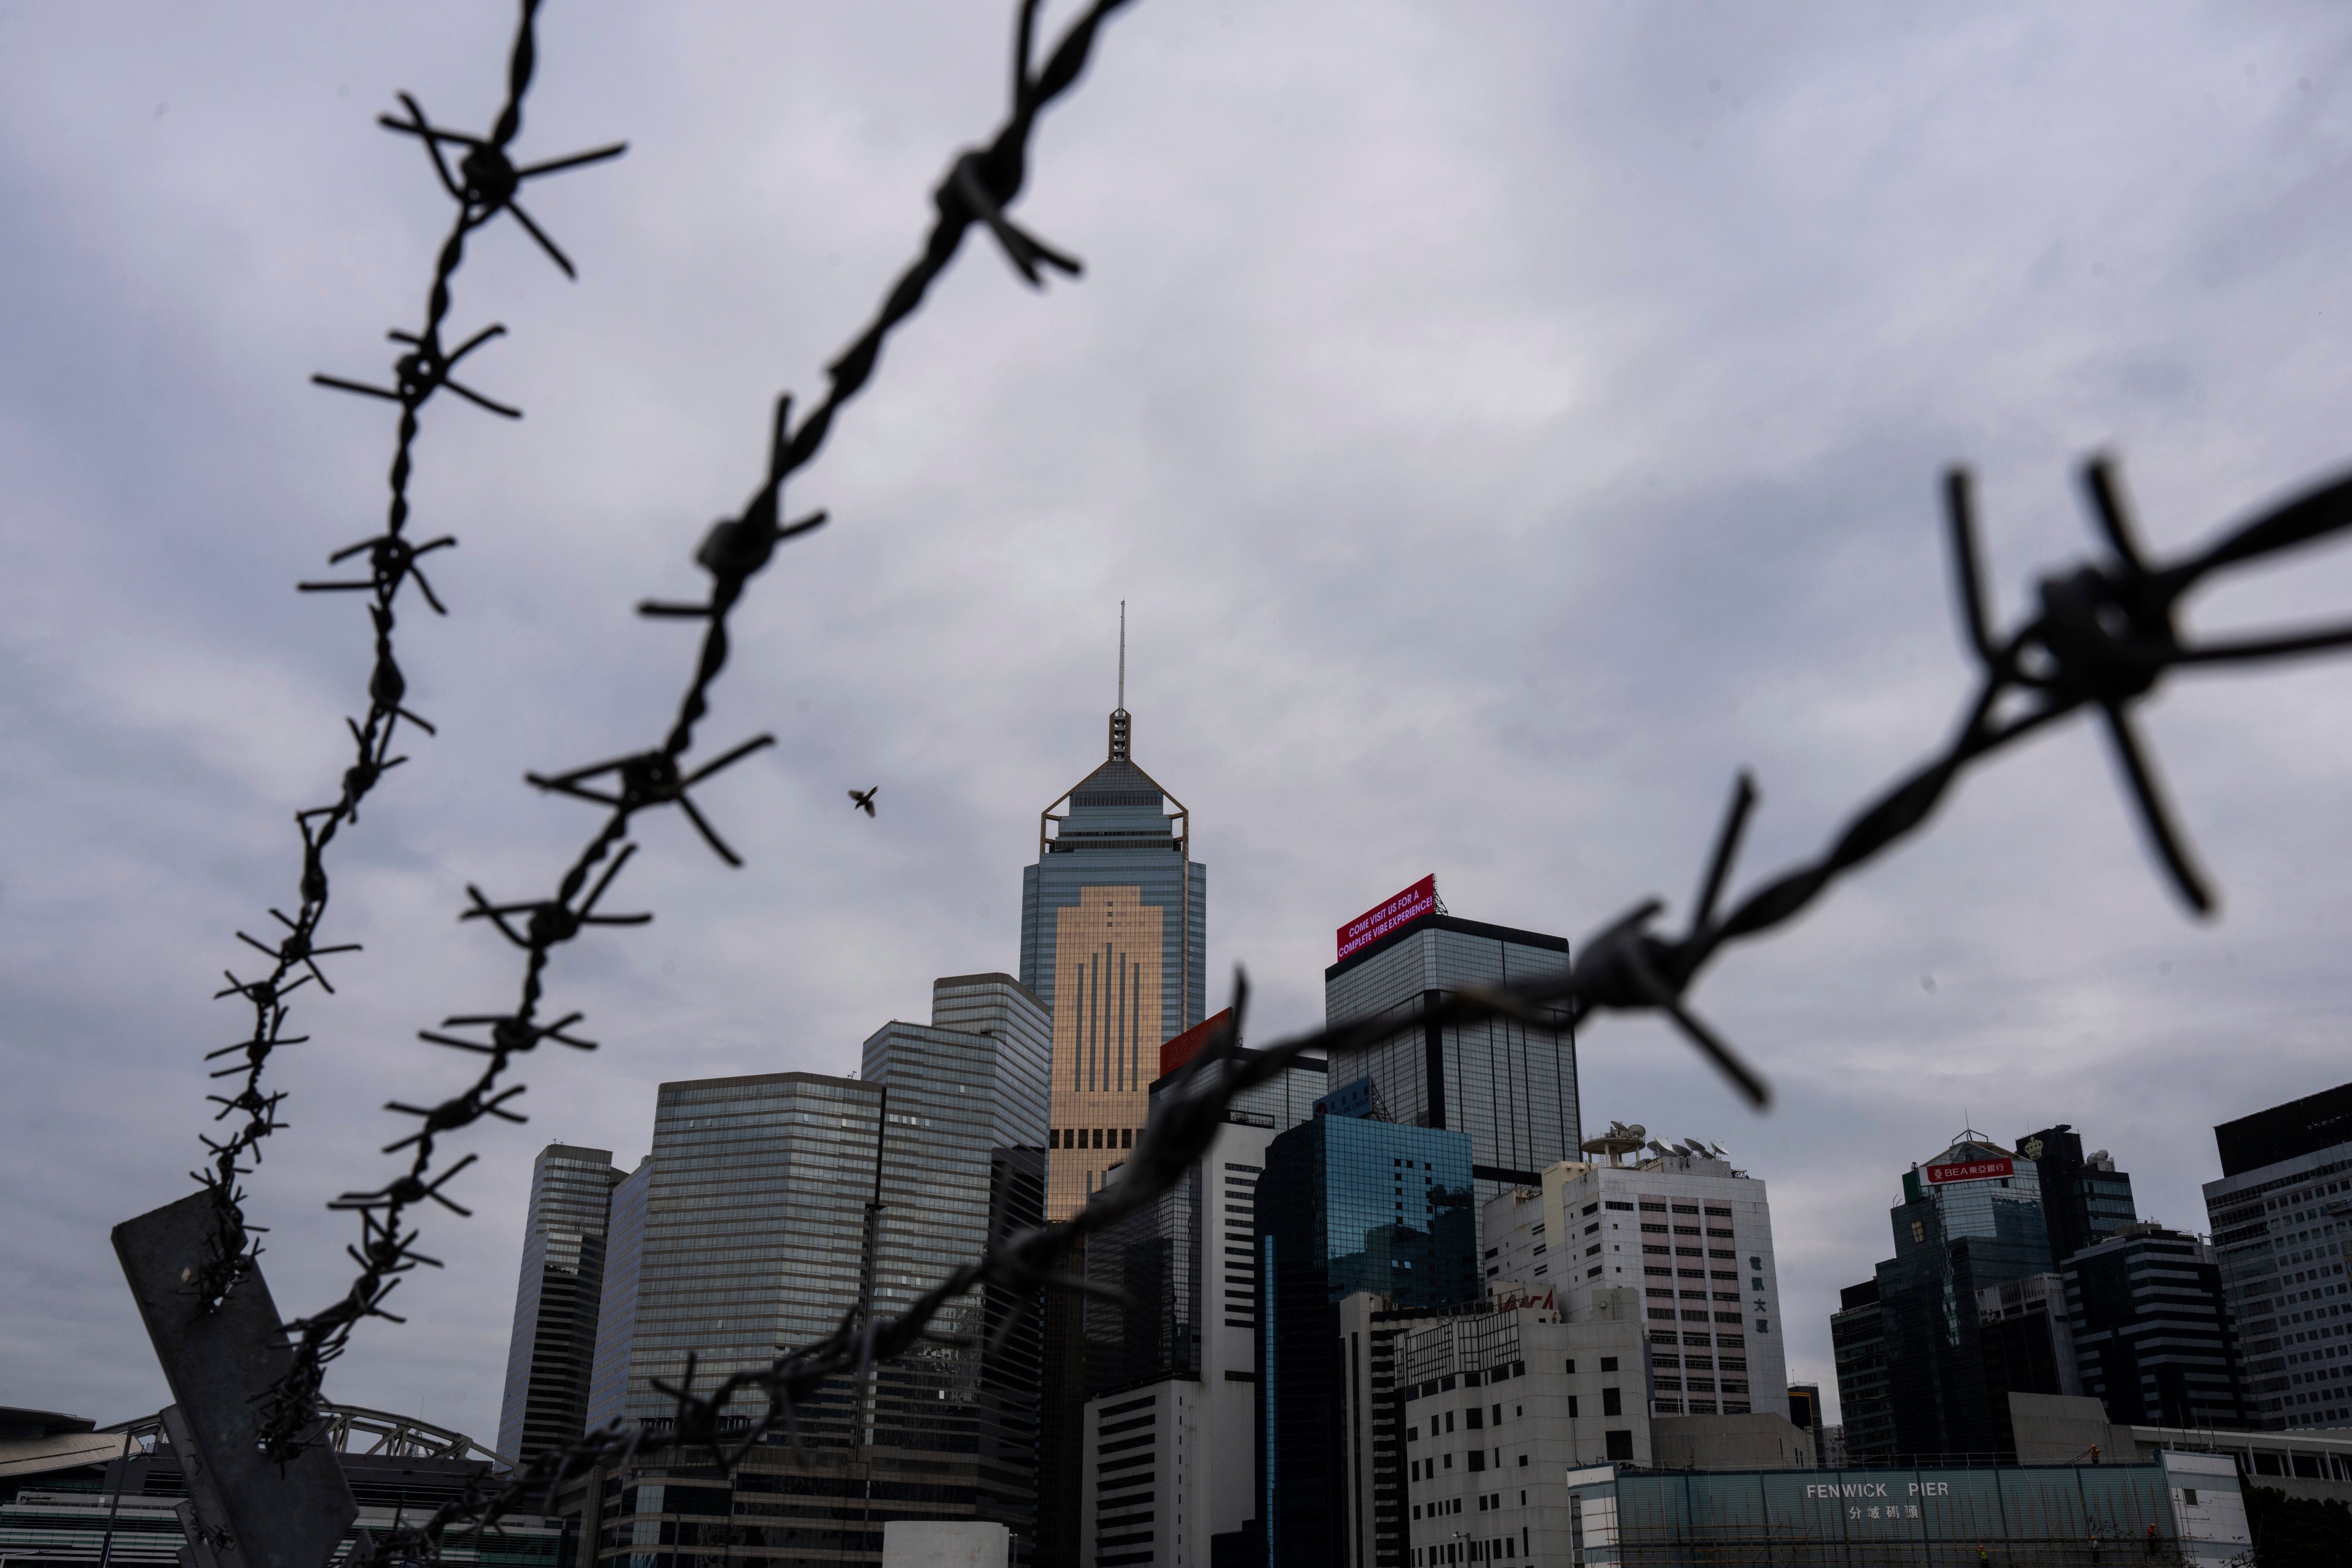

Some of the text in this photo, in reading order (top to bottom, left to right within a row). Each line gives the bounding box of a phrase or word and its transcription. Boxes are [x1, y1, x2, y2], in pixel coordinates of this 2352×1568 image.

[1349, 890, 1419, 938] COME VISIT US FOR A
[1338, 895, 1432, 958] COMPLETE VIBE EXPERIENCE!
[1343, 1105, 1351, 1114] ON
[1352, 1097, 1369, 1109] GROUP
[1945, 1164, 2004, 1176] BEA 東亞銀行
[1806, 1482, 1949, 1498] FENWICK PIER
[1849, 1505, 1919, 1520] 分域碼頭
